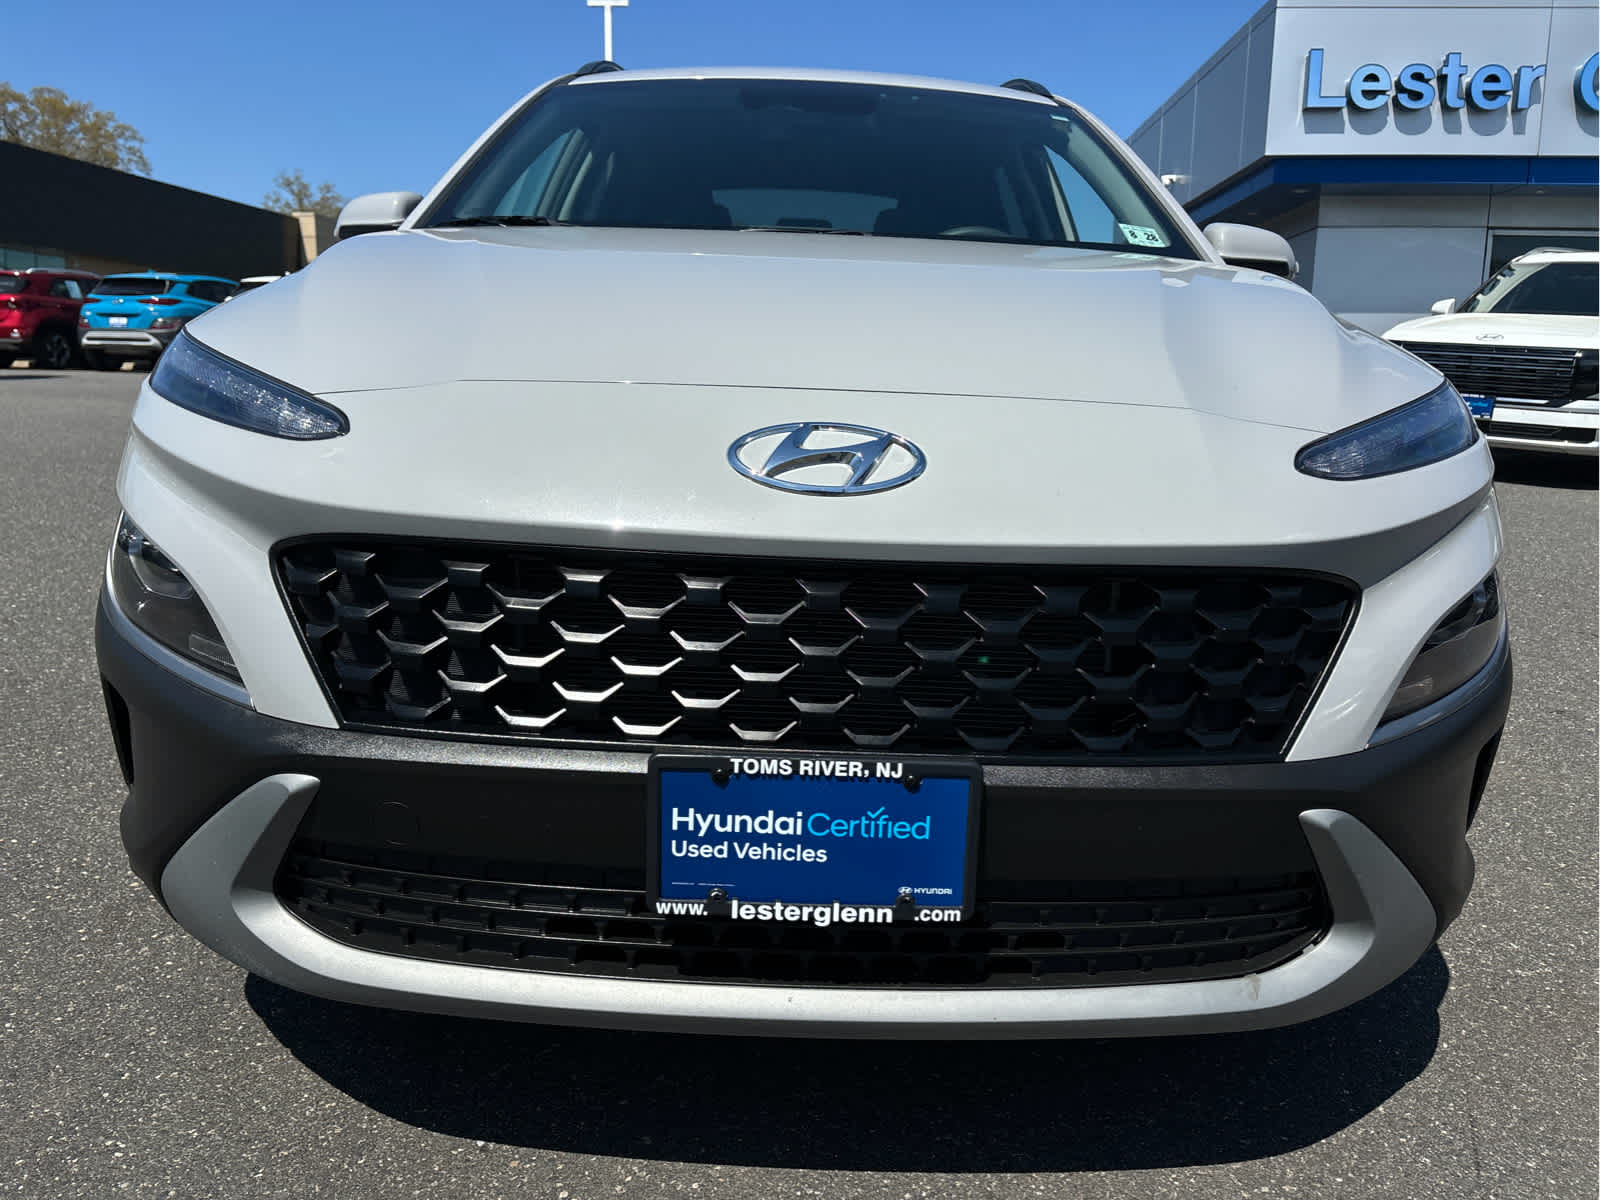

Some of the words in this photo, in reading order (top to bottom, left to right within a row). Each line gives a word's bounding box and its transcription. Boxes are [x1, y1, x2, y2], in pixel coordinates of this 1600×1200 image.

[1304, 48, 1546, 110] Lester
[730, 758, 792, 775] TOMS
[799, 760, 869, 778] RIVER,
[876, 762, 903, 778] NJ
[672, 808, 803, 837] Hyundai
[807, 807, 930, 839] Certified
[672, 840, 728, 858] Used
[734, 842, 828, 862] Vehicles
[914, 887, 953, 895] HYUNDAI
[655, 902, 708, 916] www.
[731, 899, 893, 926] lesterglenn
[914, 907, 961, 922] .com
